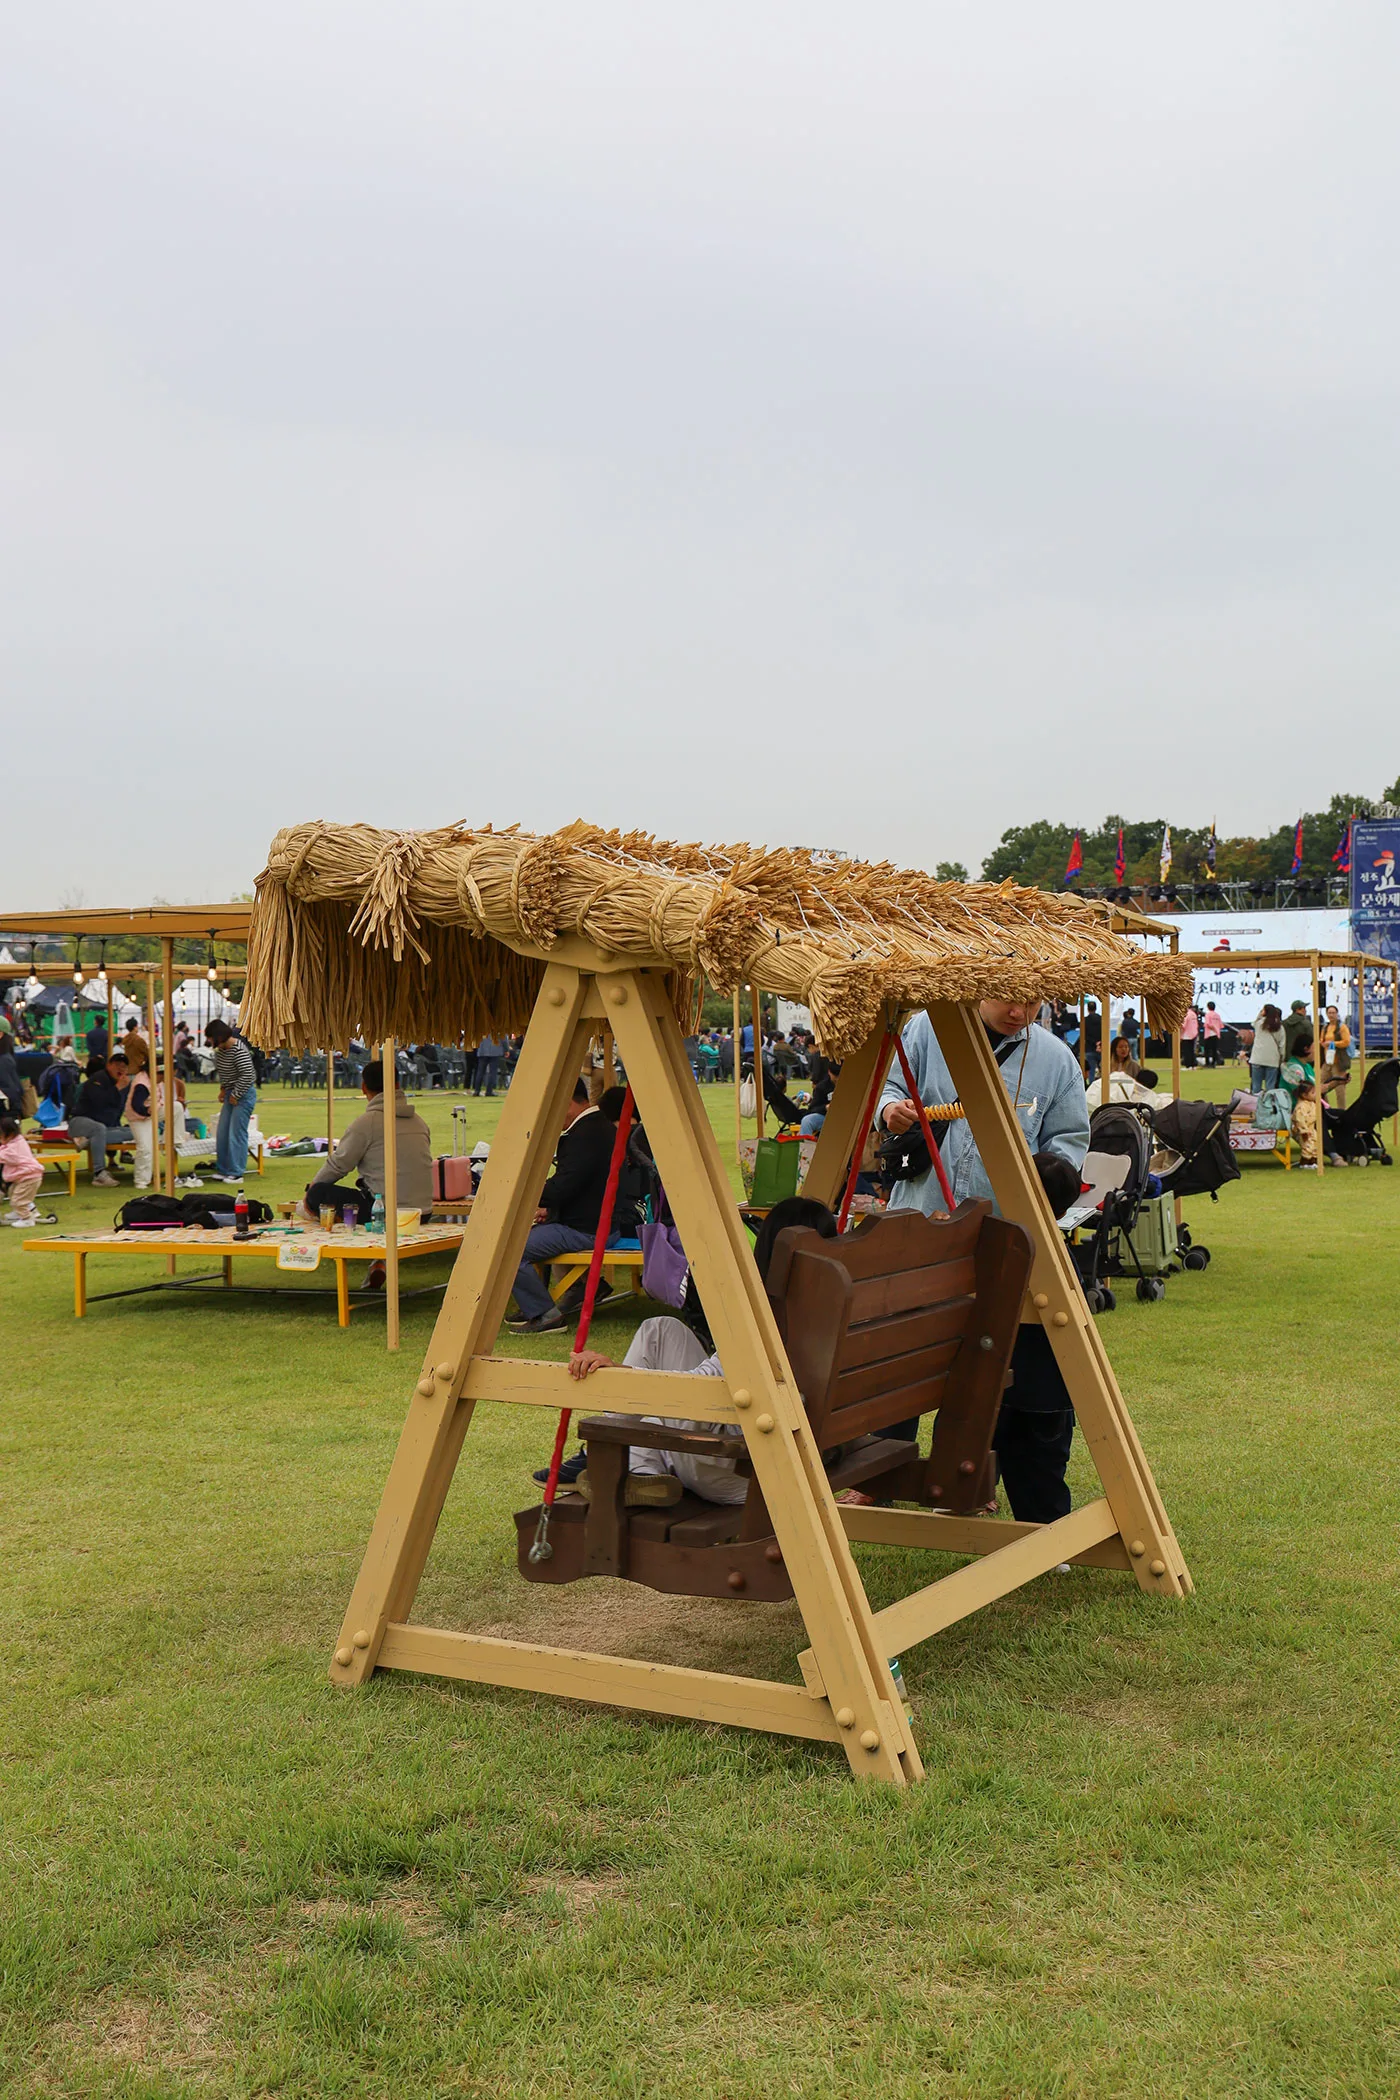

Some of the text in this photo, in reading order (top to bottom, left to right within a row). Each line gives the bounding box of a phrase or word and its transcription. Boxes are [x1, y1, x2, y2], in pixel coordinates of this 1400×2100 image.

[1360, 872, 1378, 883] 정조
[1360, 893, 1400, 907] 문화제
[1194, 981, 1235, 995] 조대왕
